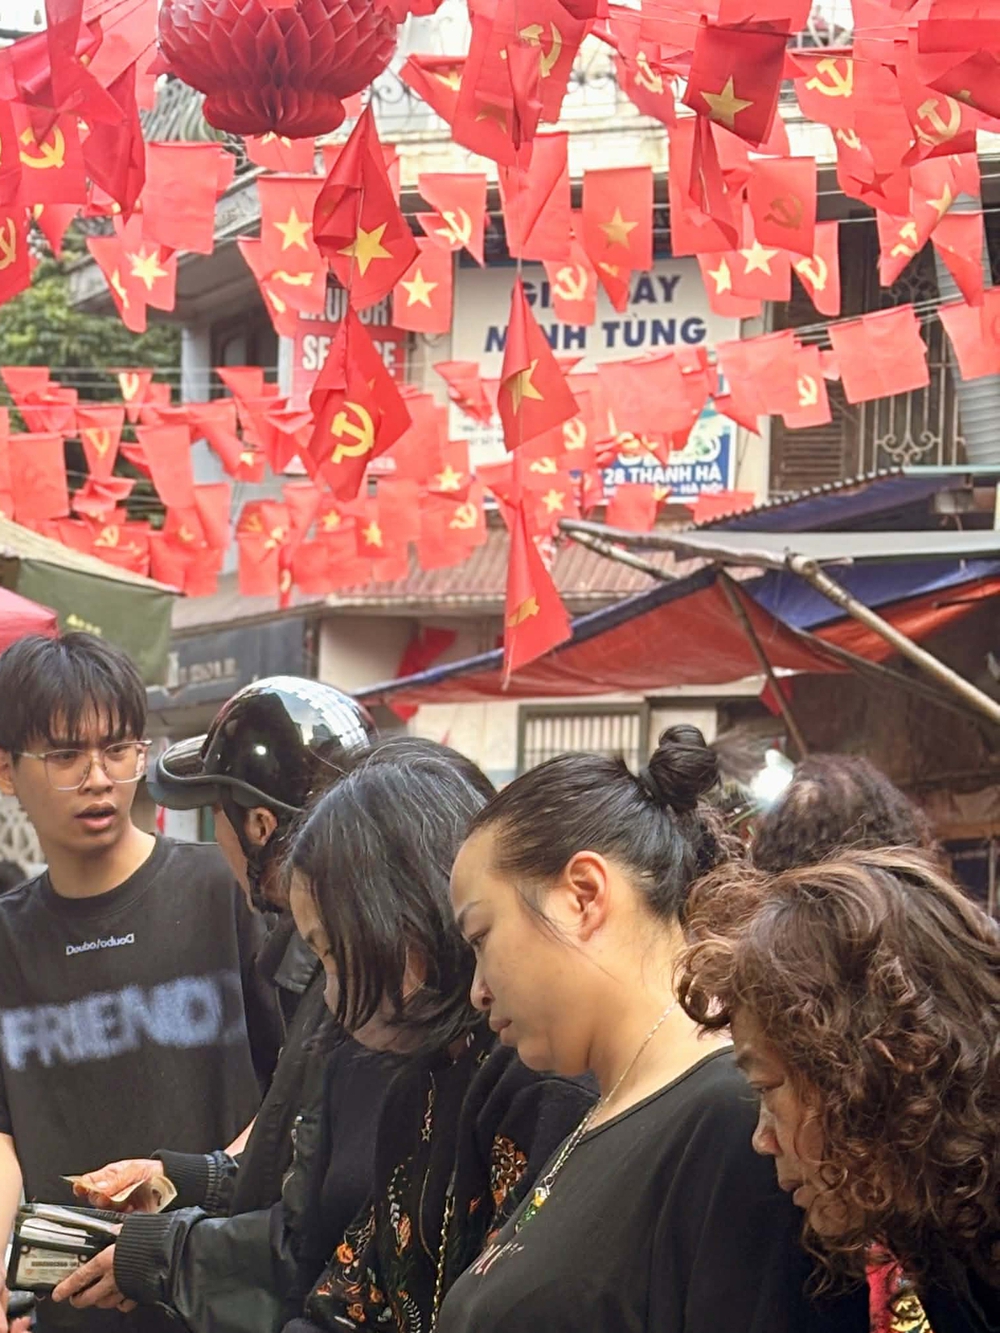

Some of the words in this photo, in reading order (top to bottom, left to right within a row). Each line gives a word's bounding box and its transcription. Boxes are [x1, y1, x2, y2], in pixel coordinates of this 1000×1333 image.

[484, 322, 587, 352] MNH
[602, 313, 707, 348] TÙNG
[628, 465, 693, 484] THANH
